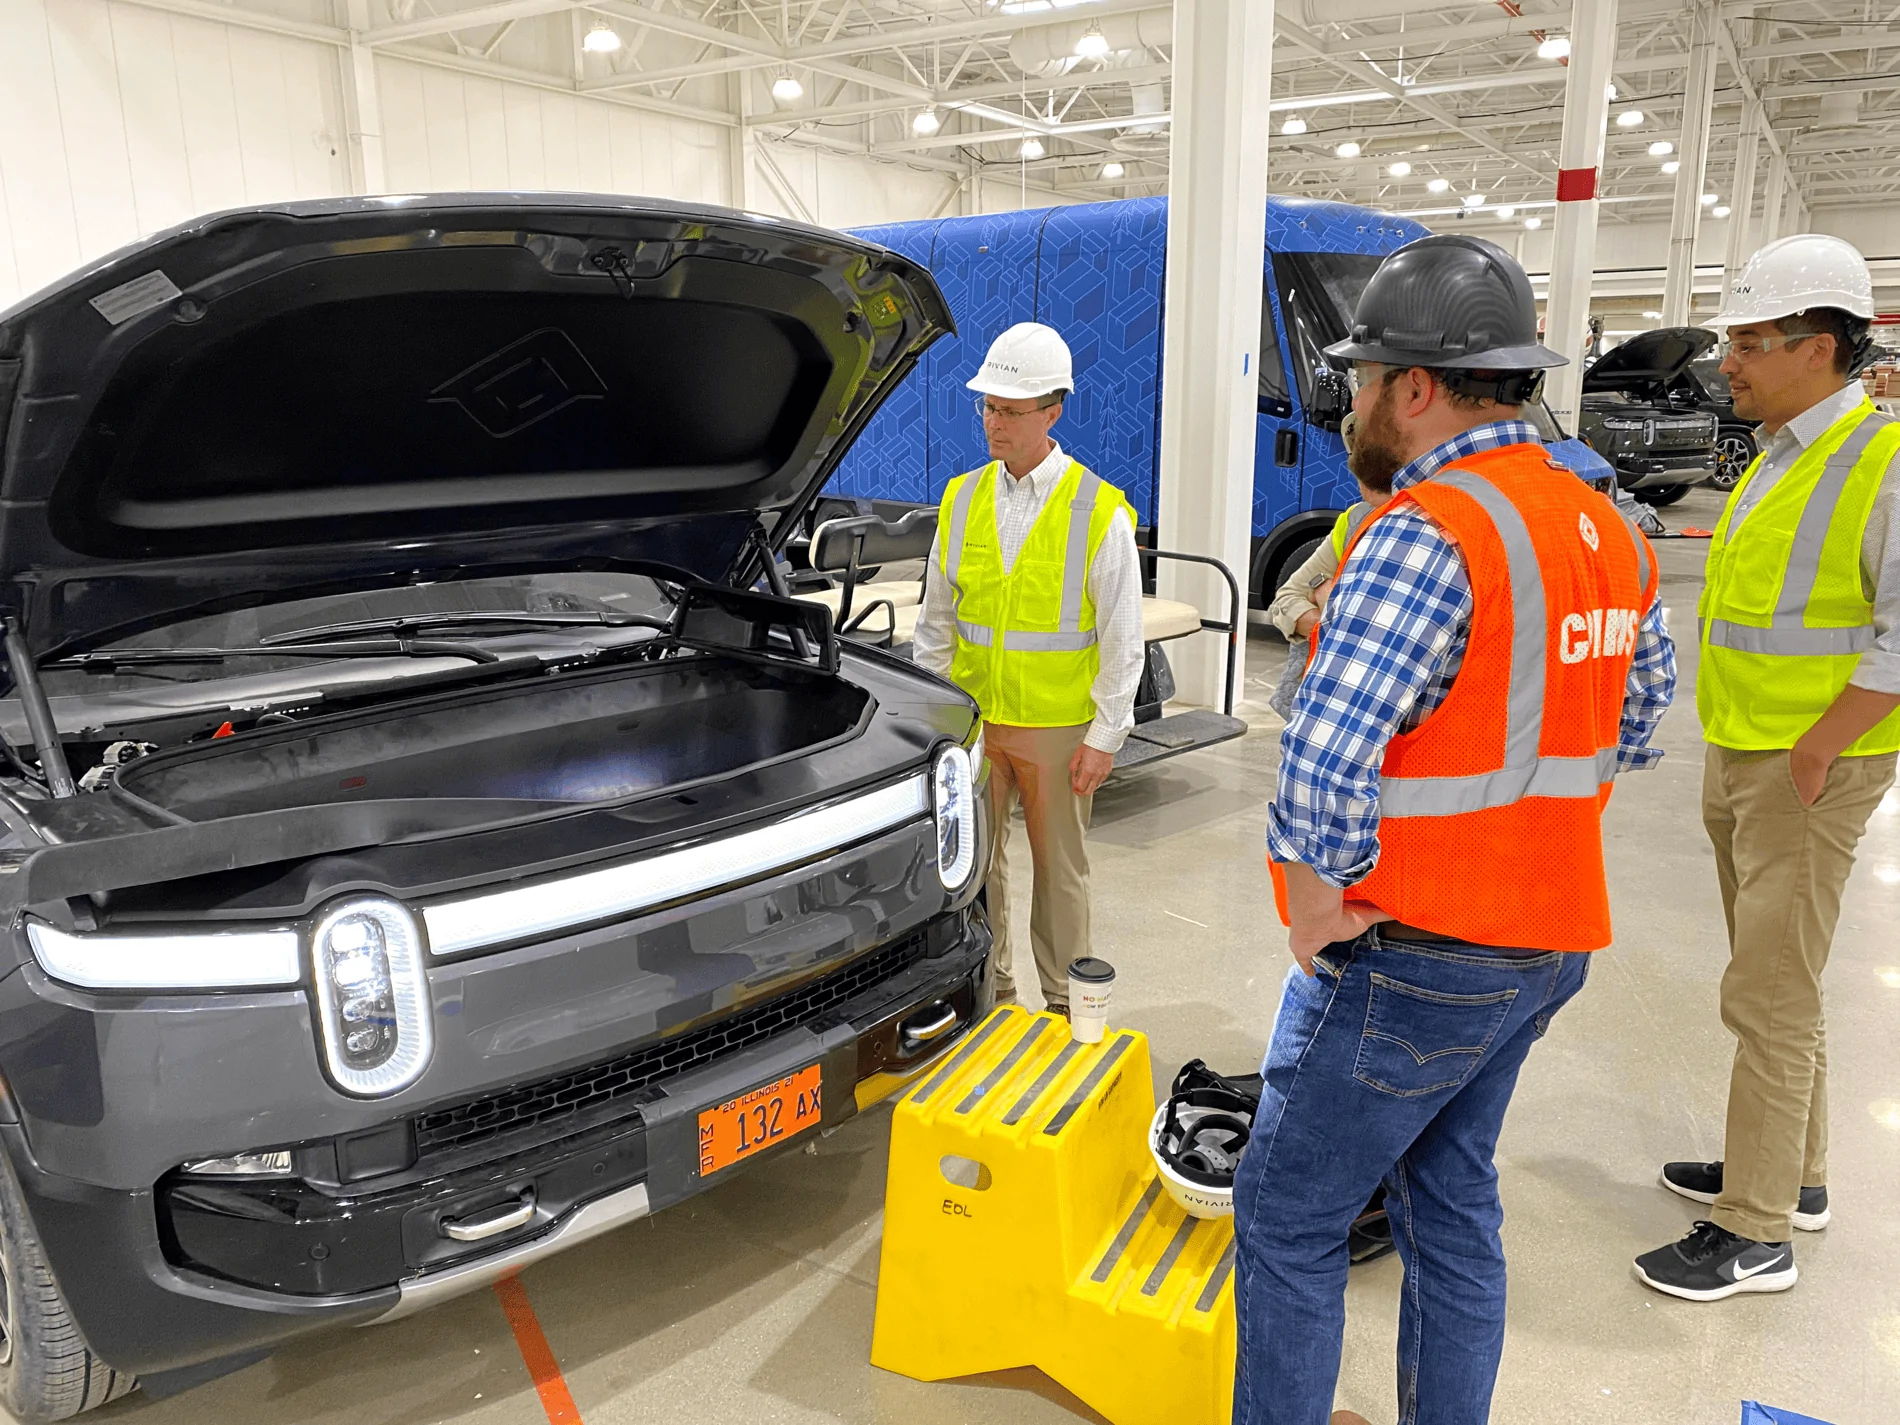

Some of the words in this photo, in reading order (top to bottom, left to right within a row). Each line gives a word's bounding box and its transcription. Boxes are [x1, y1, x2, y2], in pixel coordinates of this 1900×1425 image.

[987, 361, 1018, 373] RIVIAN
[723, 1102, 736, 1113] 20
[741, 1084, 780, 1106] ILLINOIS
[785, 1077, 793, 1087] 21
[737, 1098, 783, 1153] 132
[796, 1085, 820, 1120] AX
[1184, 1194, 1234, 1206] RIVIAN
